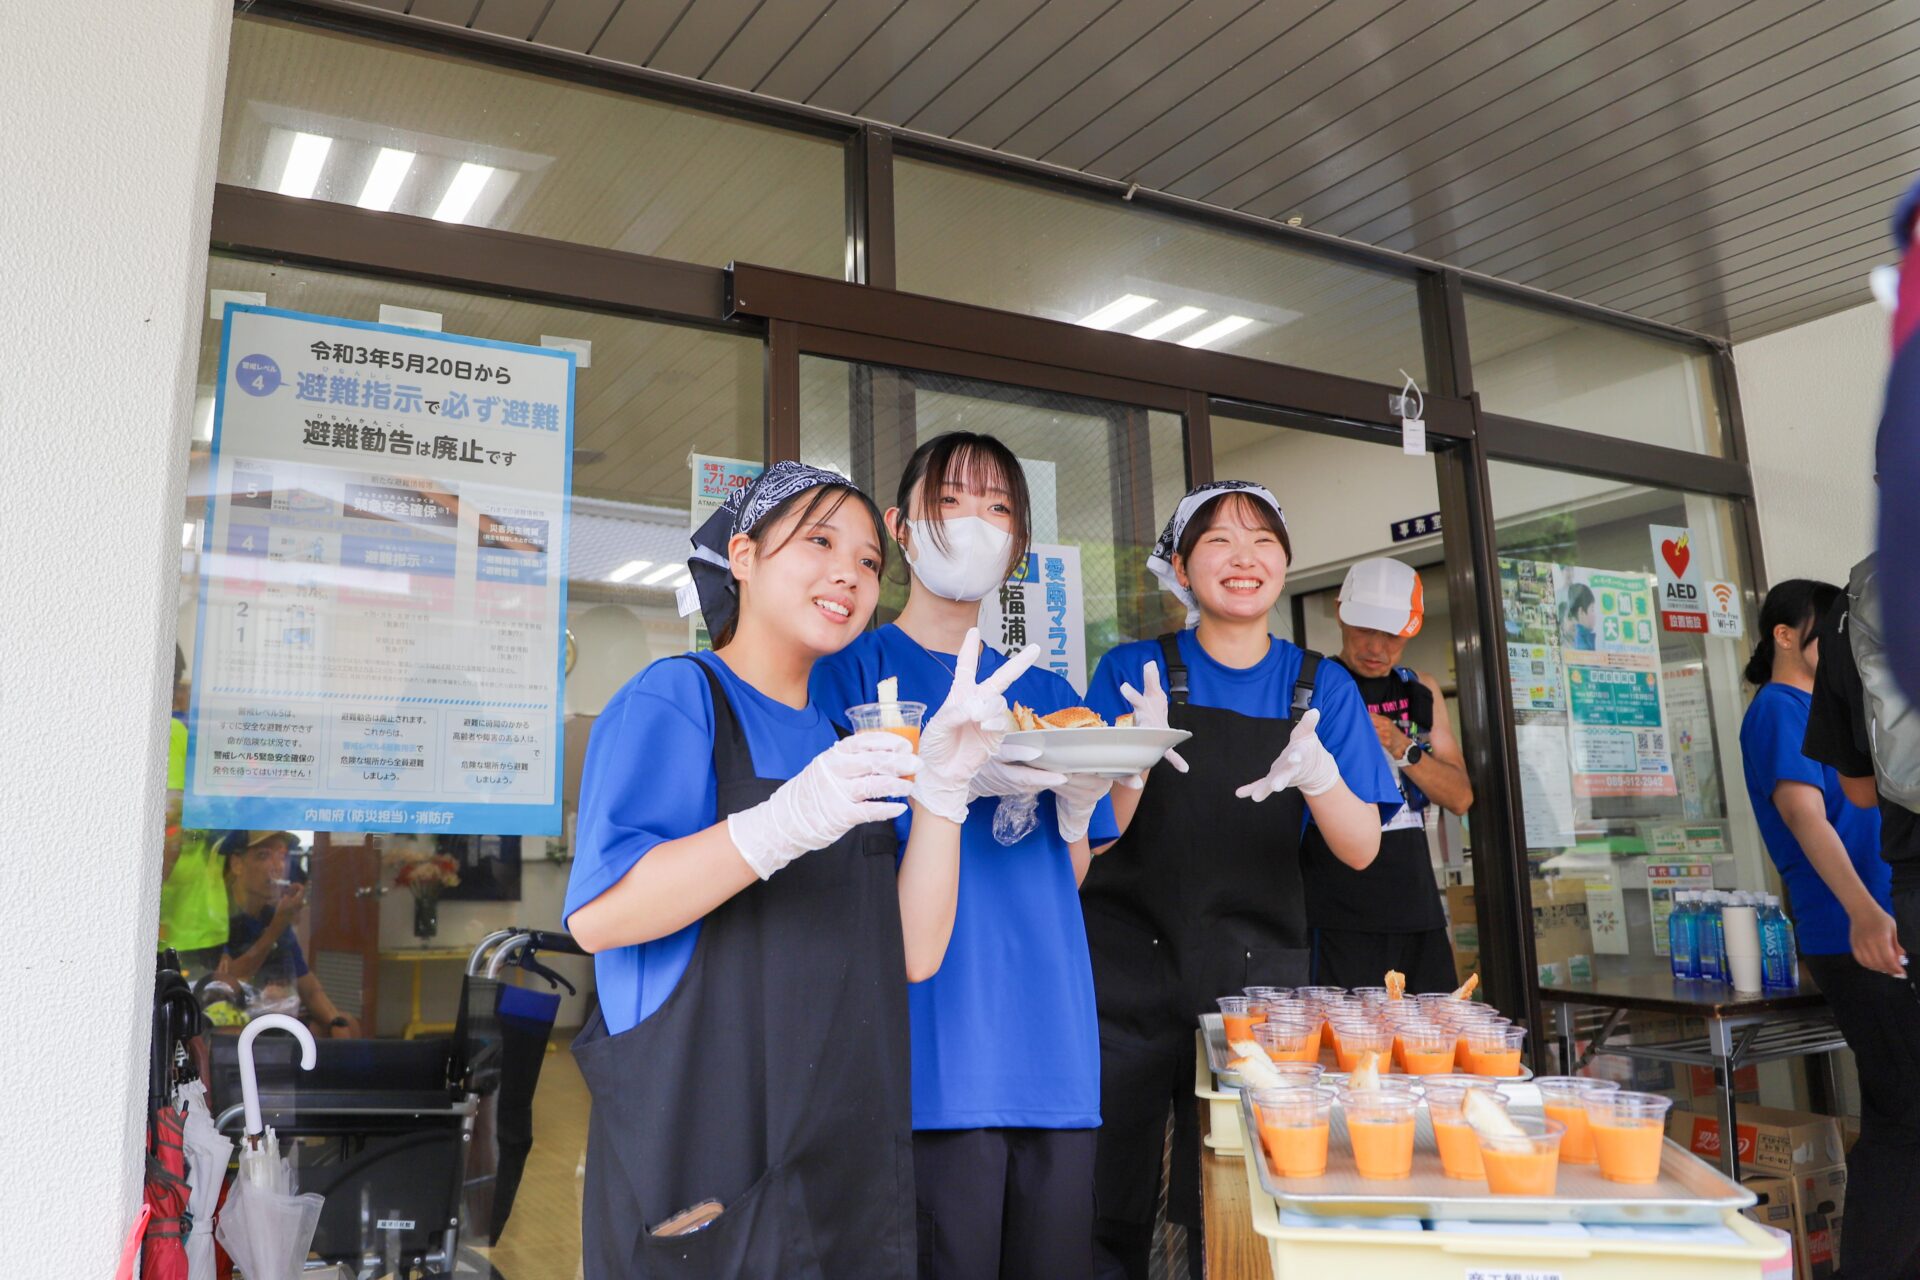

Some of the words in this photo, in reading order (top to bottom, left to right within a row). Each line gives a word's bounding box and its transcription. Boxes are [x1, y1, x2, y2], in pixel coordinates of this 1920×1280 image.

[310, 340, 512, 385] 令和3年5月20日から
[251, 375, 265, 390] 4
[295, 371, 560, 432] 避難指示で必ず避難
[302, 419, 517, 467] 避難勧告は廃止です
[245, 482, 259, 499] 5
[241, 535, 255, 551] 4
[1666, 582, 1697, 600] AED
[236, 601, 249, 617] 2
[1717, 618, 1737, 630] Wi-Fi
[236, 627, 245, 643] 1
